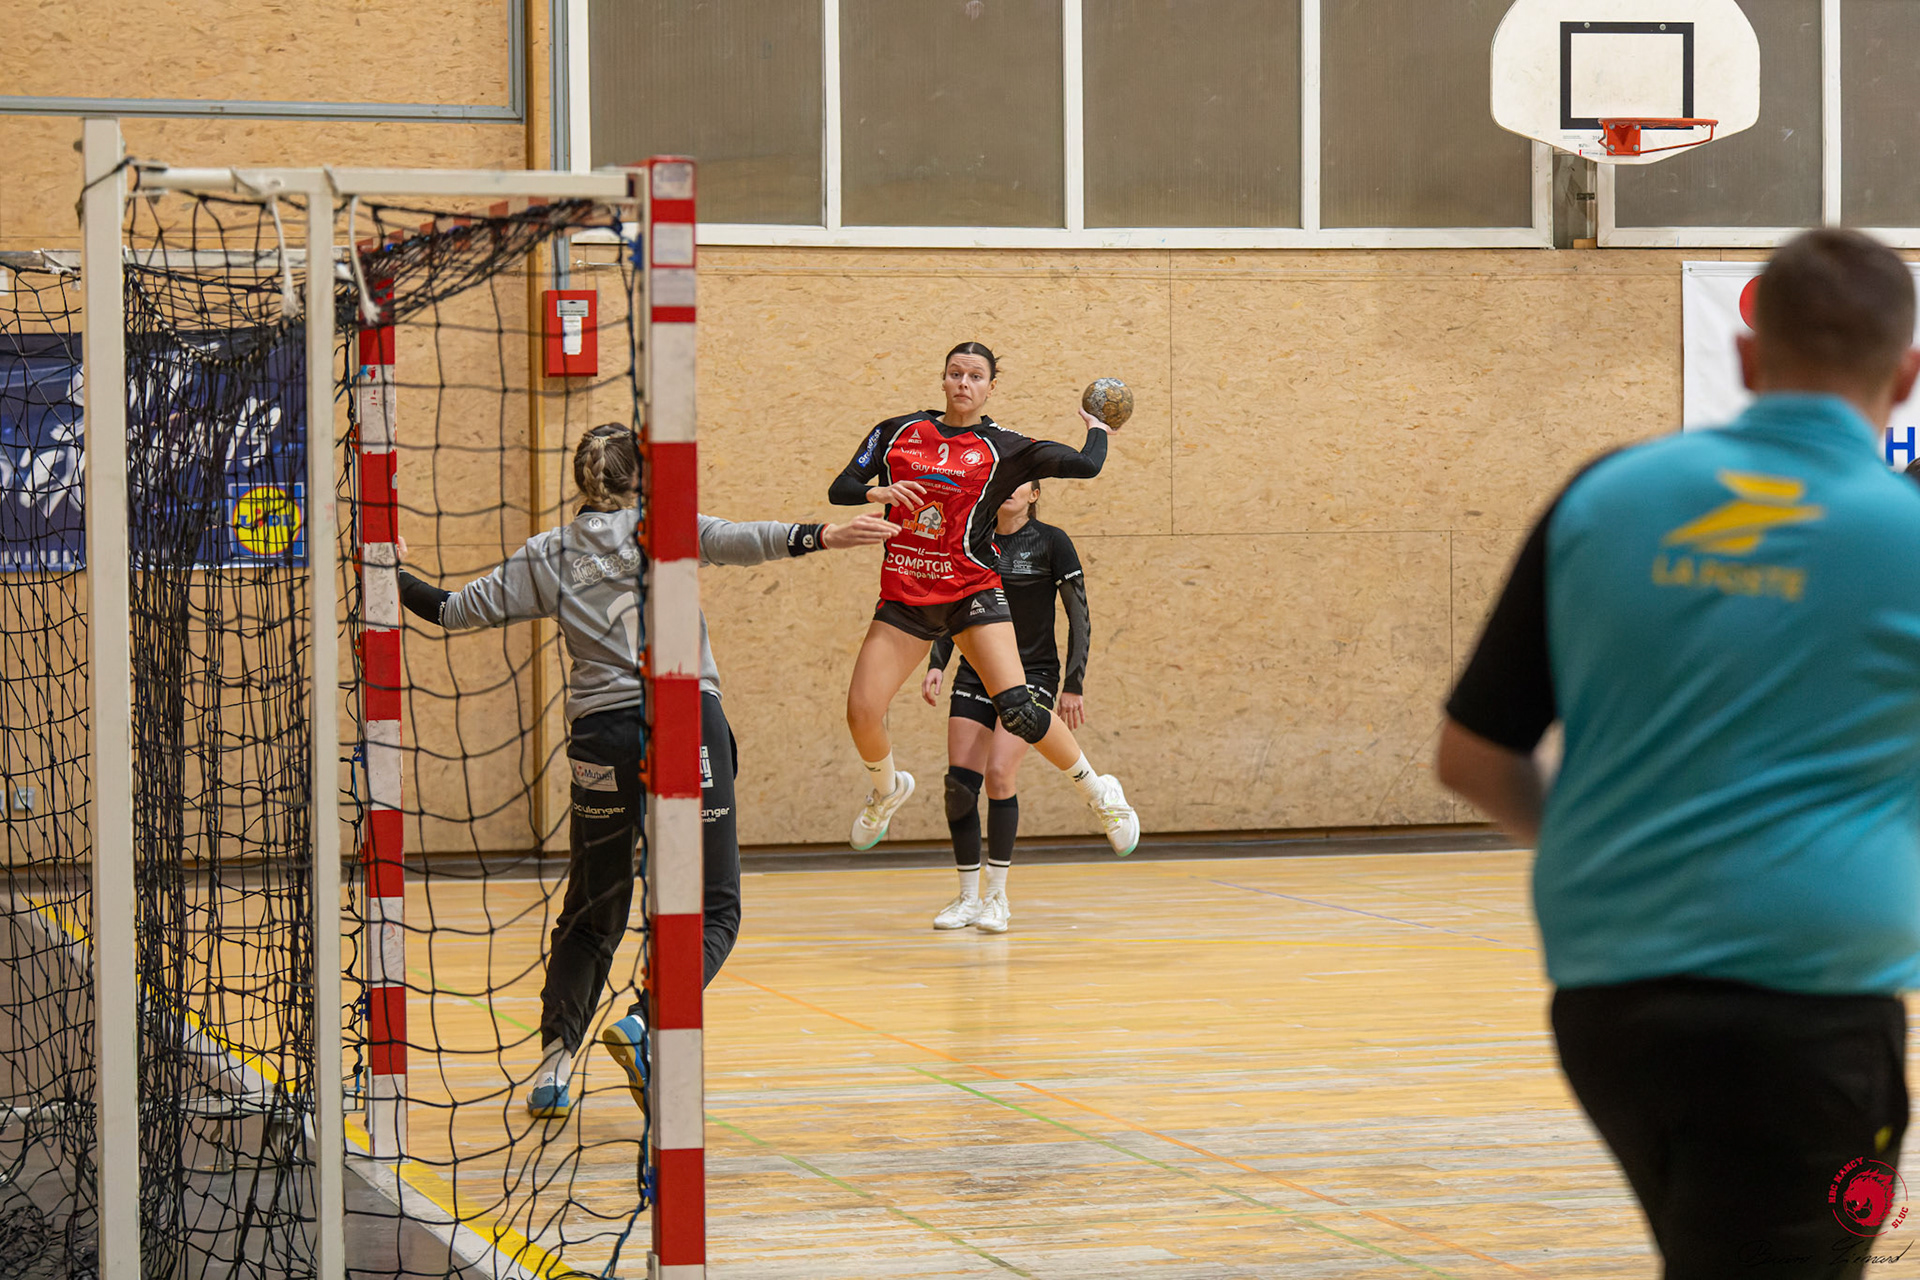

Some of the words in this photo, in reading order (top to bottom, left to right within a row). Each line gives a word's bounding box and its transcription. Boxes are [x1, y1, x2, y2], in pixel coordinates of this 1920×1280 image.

[936, 442, 950, 466] 9
[911, 461, 930, 473] Guy
[917, 547, 925, 556] LE
[700, 807, 730, 818] anger
